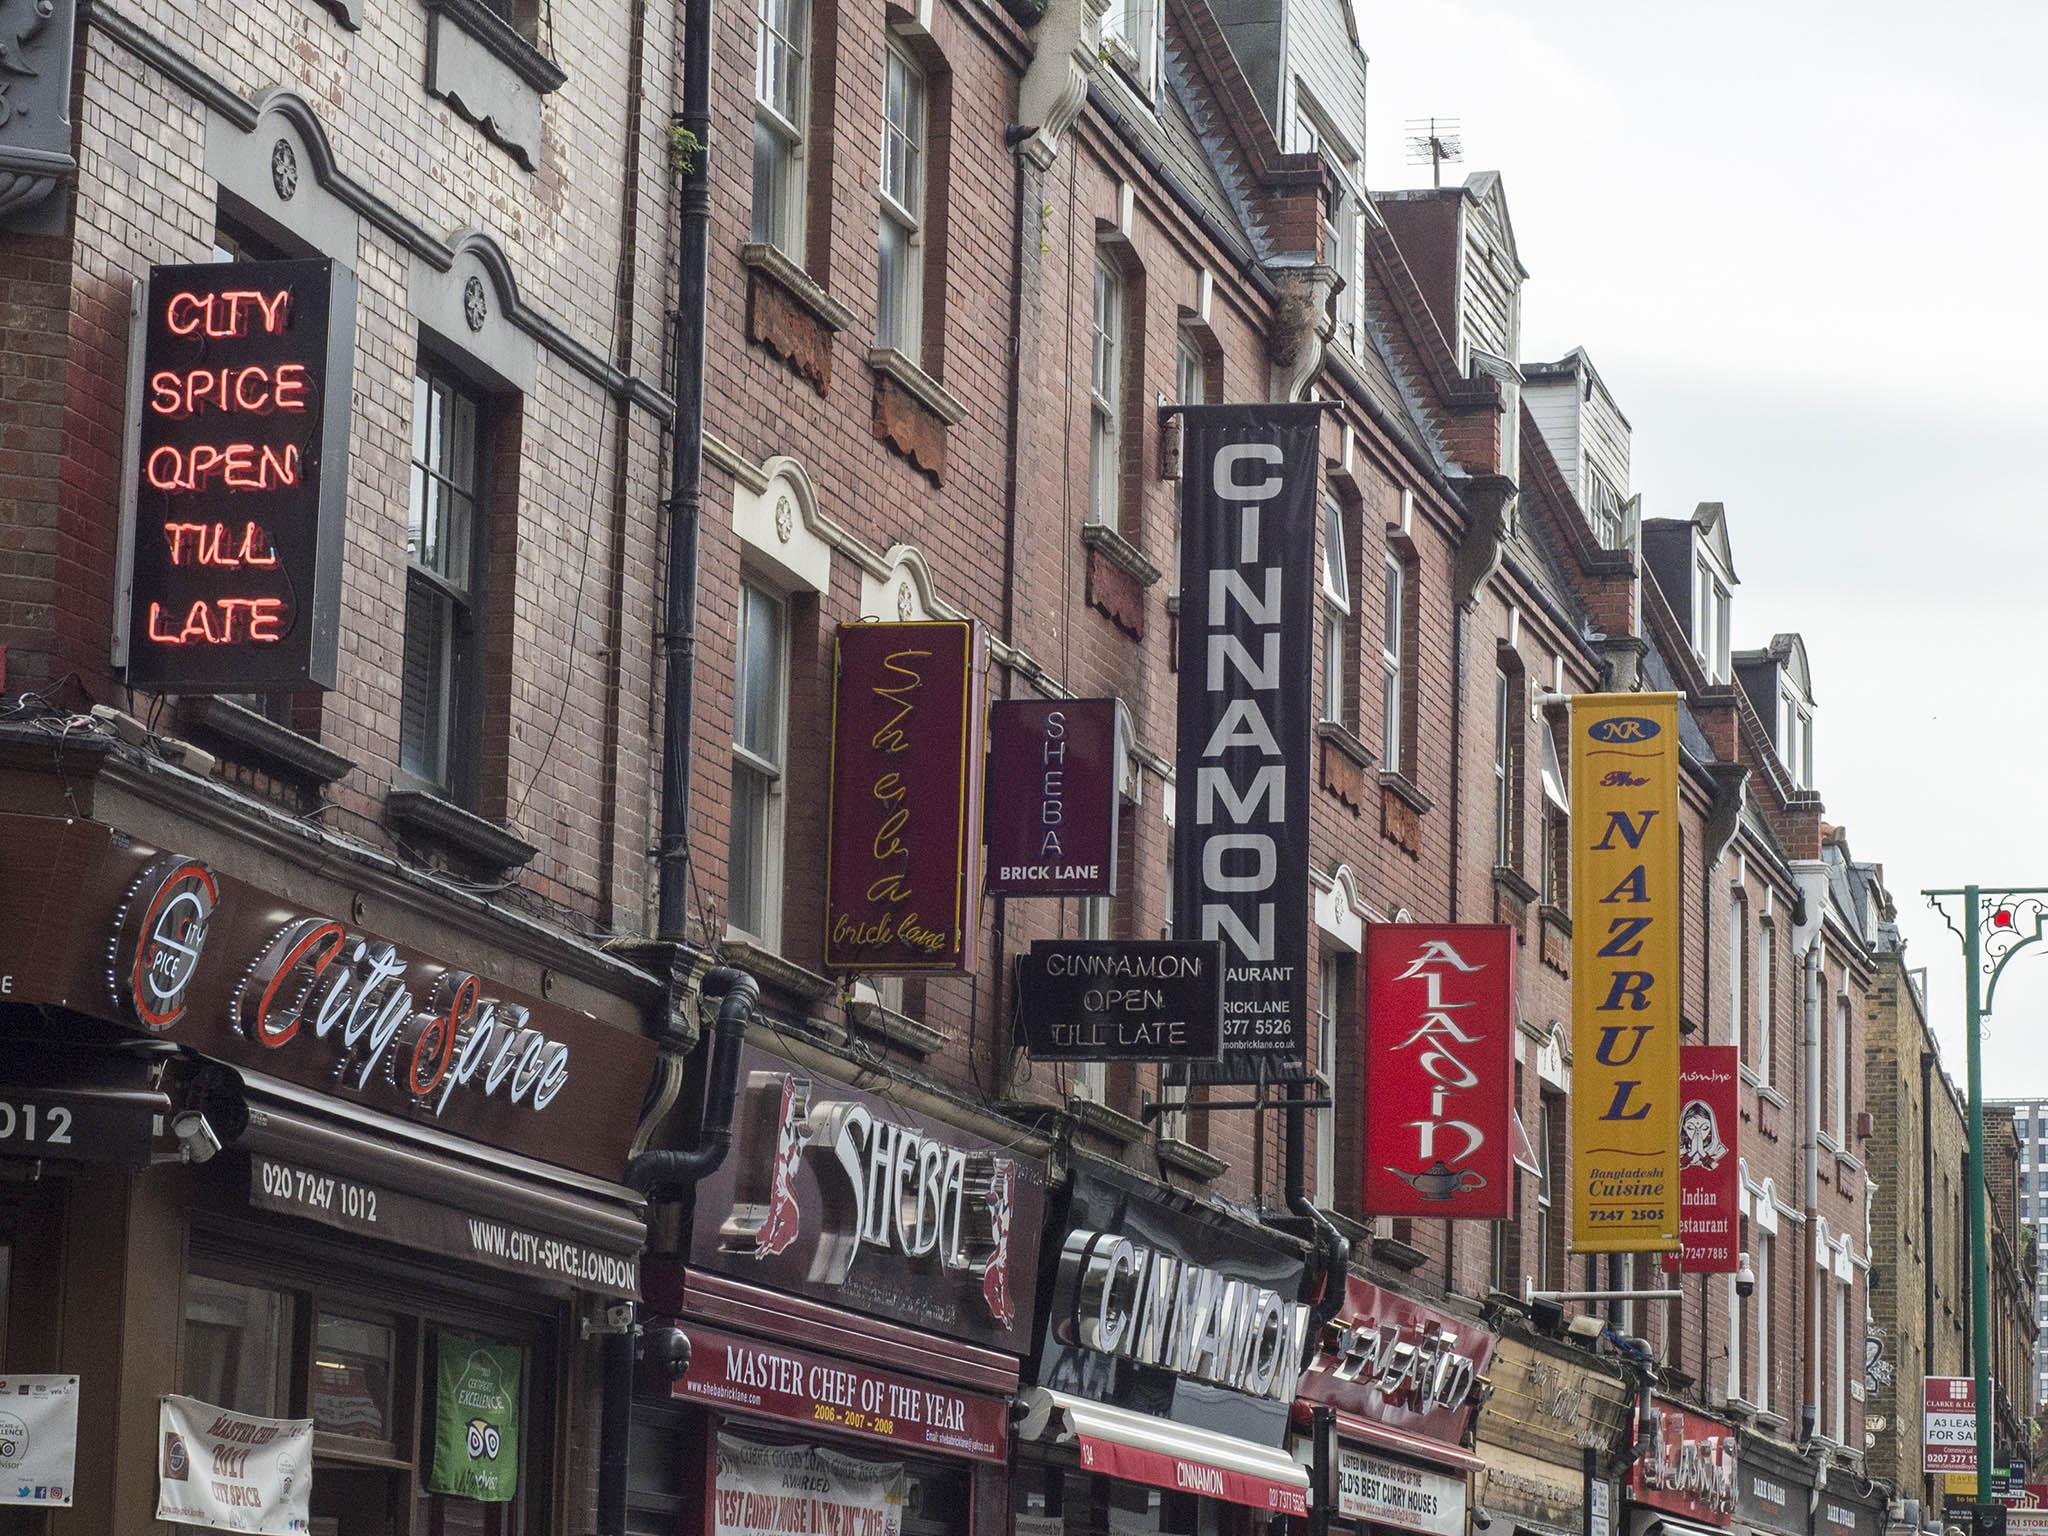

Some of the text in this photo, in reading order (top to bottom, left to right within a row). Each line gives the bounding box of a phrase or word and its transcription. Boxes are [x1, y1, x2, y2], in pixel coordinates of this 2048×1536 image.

[168, 291, 289, 337] CITY
[151, 365, 305, 414] SPICE
[148, 444, 299, 489] OPEN
[164, 521, 277, 565] TILL
[149, 599, 281, 644] LATE
[1196, 444, 1286, 961] CINNAMON
[1602, 720, 1647, 741] NR
[1041, 711, 1066, 856] SHEBA
[1600, 771, 1650, 788] The
[1000, 865, 1098, 880] BRICK LANE
[144, 942, 180, 978] SPICE
[1047, 953, 1203, 978] CINNAMON
[1590, 810, 1660, 1121] NAZRUL
[1224, 967, 1294, 981] AURANT
[1082, 989, 1164, 1013] OPEN
[1223, 1001, 1290, 1013] RICKLANE
[258, 922, 568, 1118] City Spice
[1255, 1020, 1291, 1034] 5526
[1050, 1022, 1187, 1047] TILL LATE
[1590, 1168, 1664, 1180] Bangladeshi
[263, 1162, 377, 1222] 020 7247 1012
[834, 1102, 967, 1276] SHEBA
[1589, 1179, 1664, 1197] Cuisine
[1682, 1187, 1717, 1206] Indian
[1589, 1210, 1664, 1221] 7247 2505
[1680, 1217, 1728, 1233] estaurant
[468, 1218, 636, 1292] WWW.CITY-SPICE.LONDON
[1686, 1248, 1706, 1260] 7247
[1708, 1248, 1728, 1260] 7885
[1099, 1236, 1309, 1403] CINNAMON
[687, 1380, 762, 1405] www.shebabricklane.com
[726, 1345, 966, 1432] MASTER CHEF OF THE YEAR
[207, 1416, 254, 1443] MASTER
[814, 1404, 836, 1422] 2006
[845, 1410, 865, 1428] 2007
[874, 1415, 894, 1435] 2008
[1934, 1419, 1976, 1428] A3 LEAS
[1929, 1431, 1954, 1440] FOR
[212, 1444, 251, 1479] 2017
[1082, 1444, 1093, 1465] 134
[1343, 1453, 1359, 1471] LISTED
[1927, 1454, 1948, 1463] 0207
[1951, 1454, 1966, 1463] 377
[1943, 1446, 1974, 1454] Commercial
[1177, 1461, 1224, 1495] CINNAMON
[1339, 1471, 1360, 1495] RLD'S
[1361, 1477, 1381, 1501] BEST
[1382, 1483, 1407, 1508] CURRY
[229, 1484, 262, 1508] SPICE
[744, 1491, 778, 1530] CURRY
[777, 1494, 807, 1533] HOUSE
[2007, 1519, 2020, 1527] TAJ
